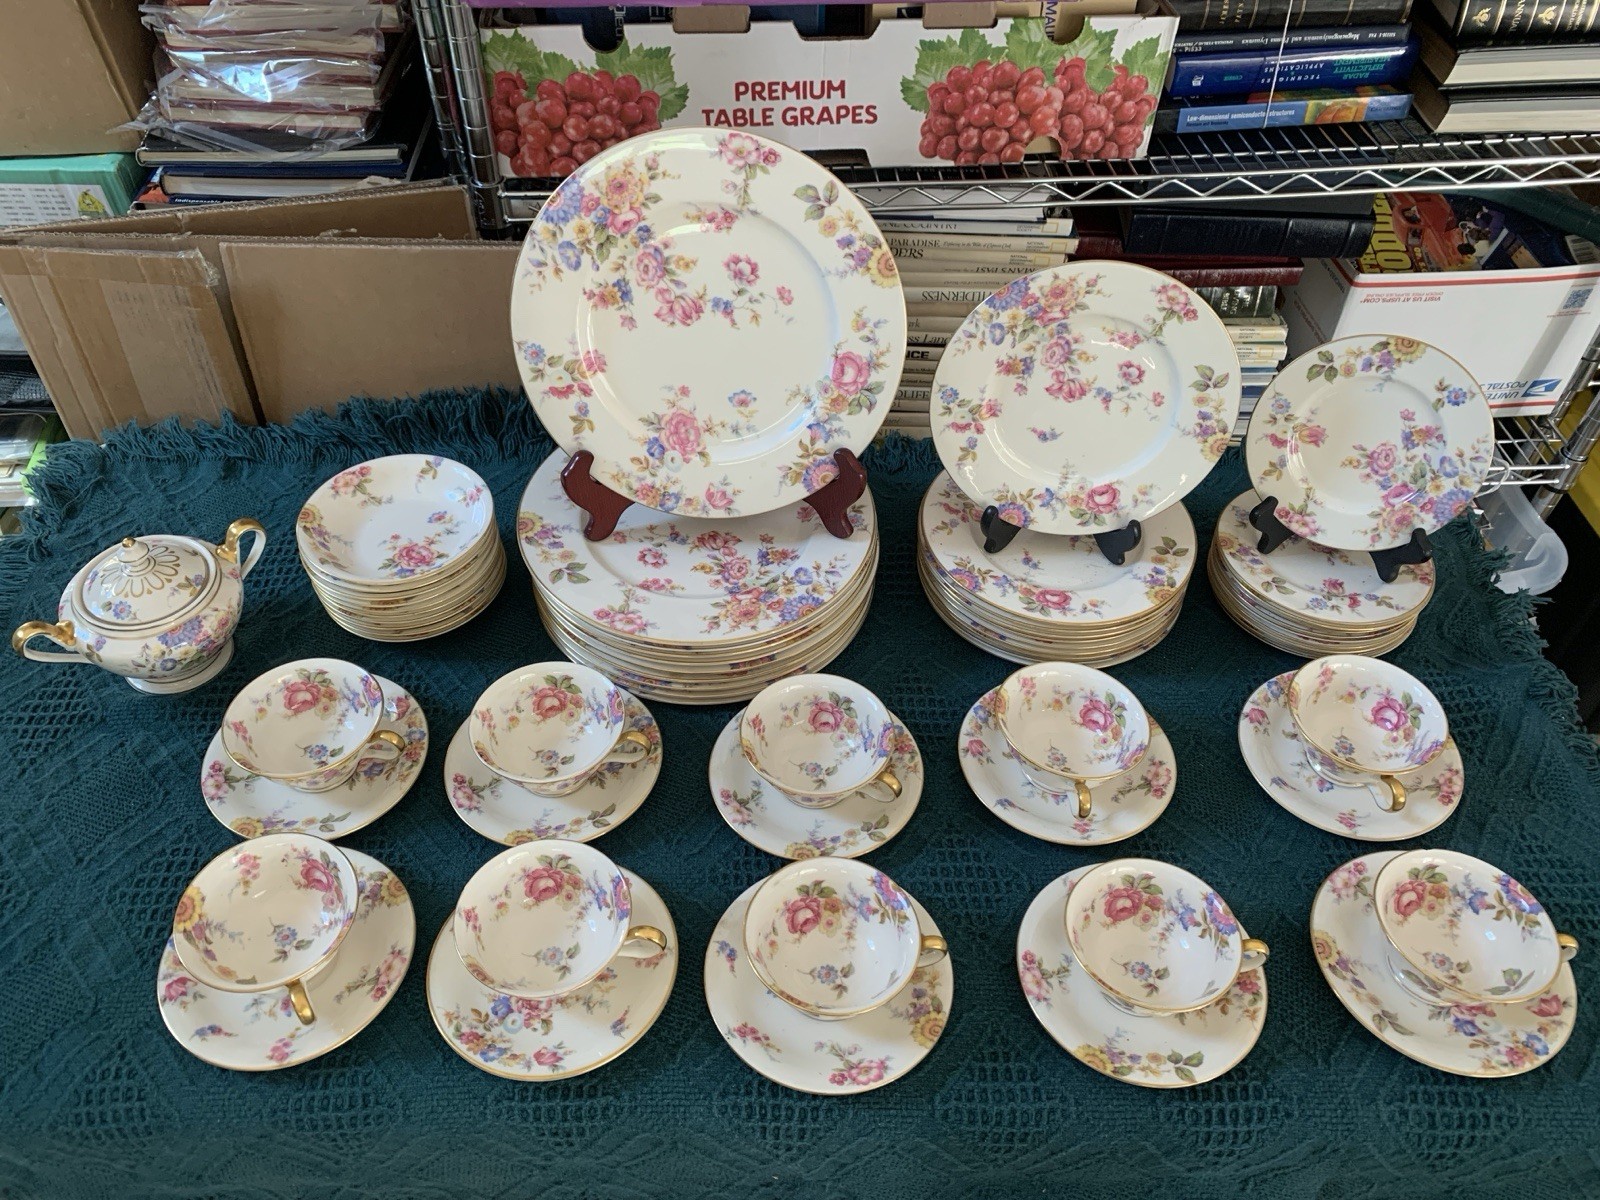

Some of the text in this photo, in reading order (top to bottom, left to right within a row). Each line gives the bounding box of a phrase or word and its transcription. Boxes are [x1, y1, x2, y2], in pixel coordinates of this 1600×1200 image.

[1333, 63, 1385, 74] REFLECTIVITY
[1261, 74, 1321, 84] TECHNIQES
[1342, 72, 1371, 80] RADAR
[734, 79, 846, 102] PREMIUM
[701, 104, 878, 127] TABLE GRAPES
[1230, 110, 1267, 119] semiconducto
[890, 239, 940, 248] PARADISE
[1487, 381, 1528, 390] POSTAL
